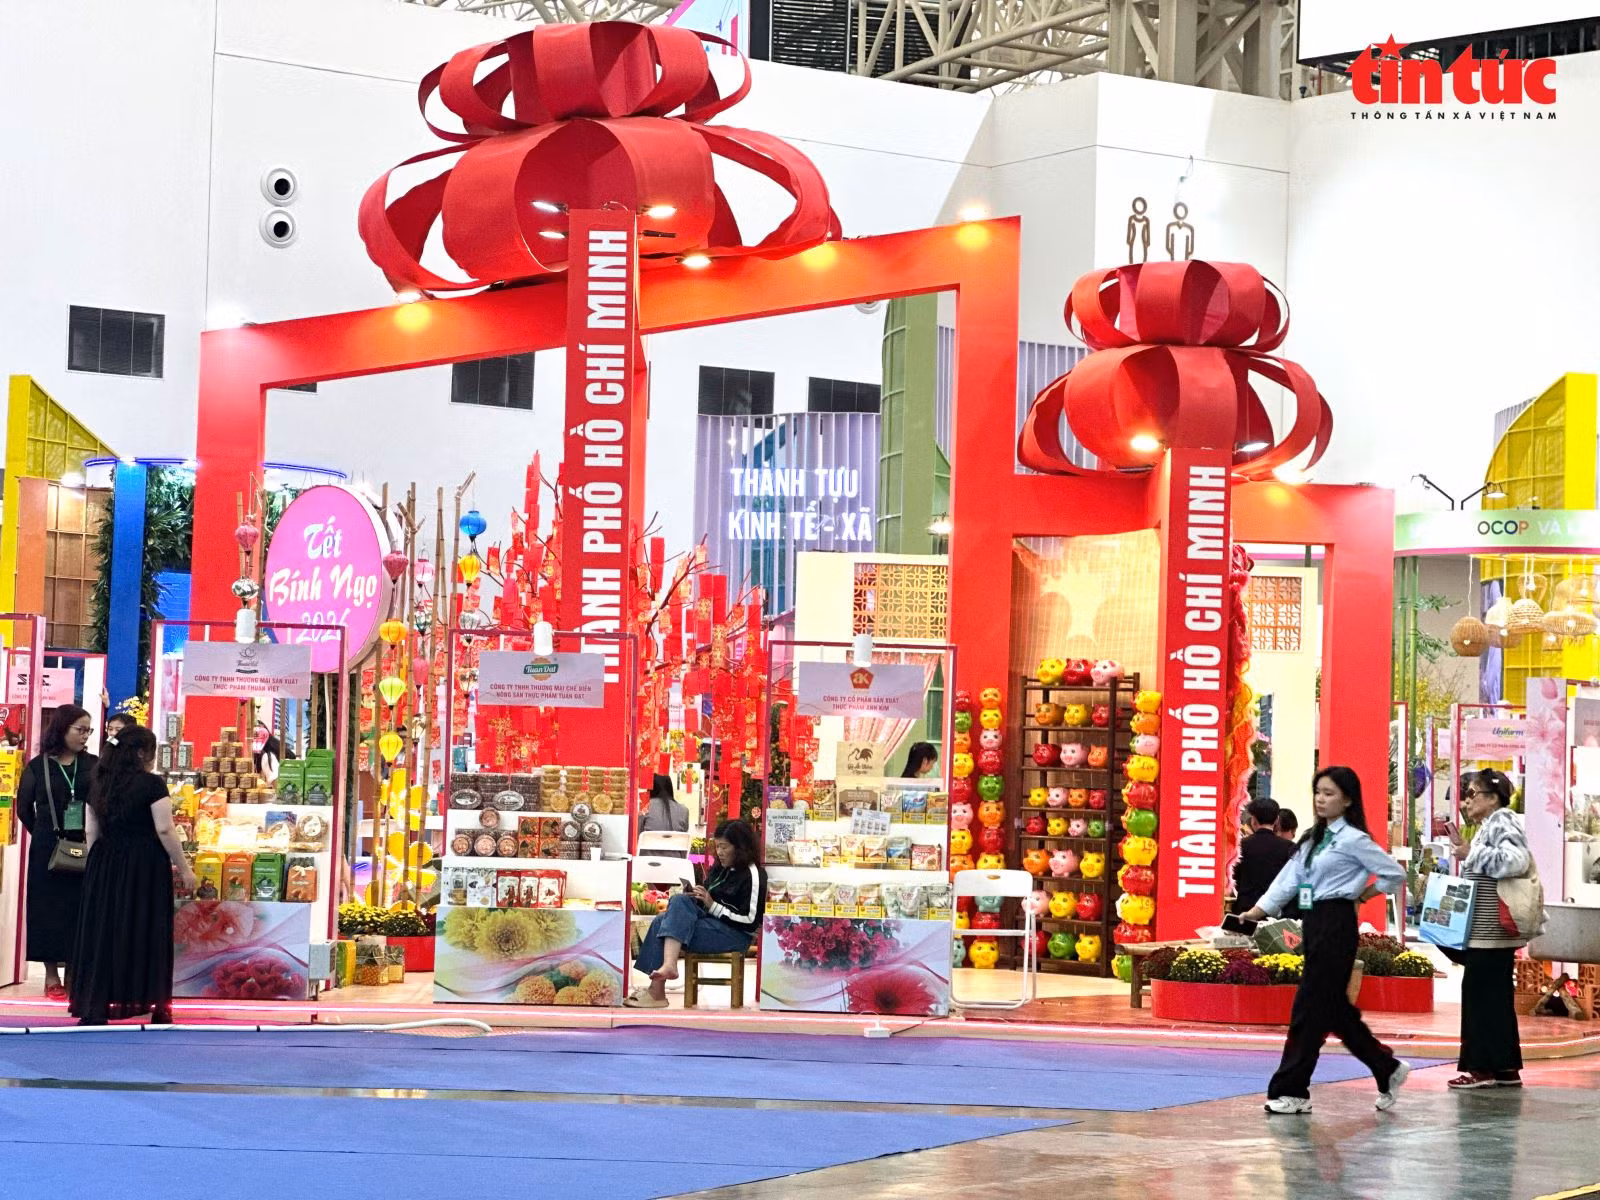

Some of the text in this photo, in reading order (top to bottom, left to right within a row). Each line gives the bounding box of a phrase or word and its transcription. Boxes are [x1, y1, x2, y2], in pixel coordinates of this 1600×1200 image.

[587, 230, 627, 329] MINH
[578, 344, 624, 405] CHÍ
[570, 419, 623, 466] HỒ
[730, 462, 858, 503] THÀNH TỰU
[304, 515, 342, 560] Tết
[570, 482, 622, 553] PHỐ
[728, 511, 780, 539] KINH
[790, 500, 817, 540] TẾ
[842, 507, 871, 541] XÃ
[1478, 520, 1529, 535] OCOP
[269, 564, 377, 608] Bính Ngọ
[1169, 466, 1225, 897] THÀNH PHỐ HỒ CHÍ MINH
